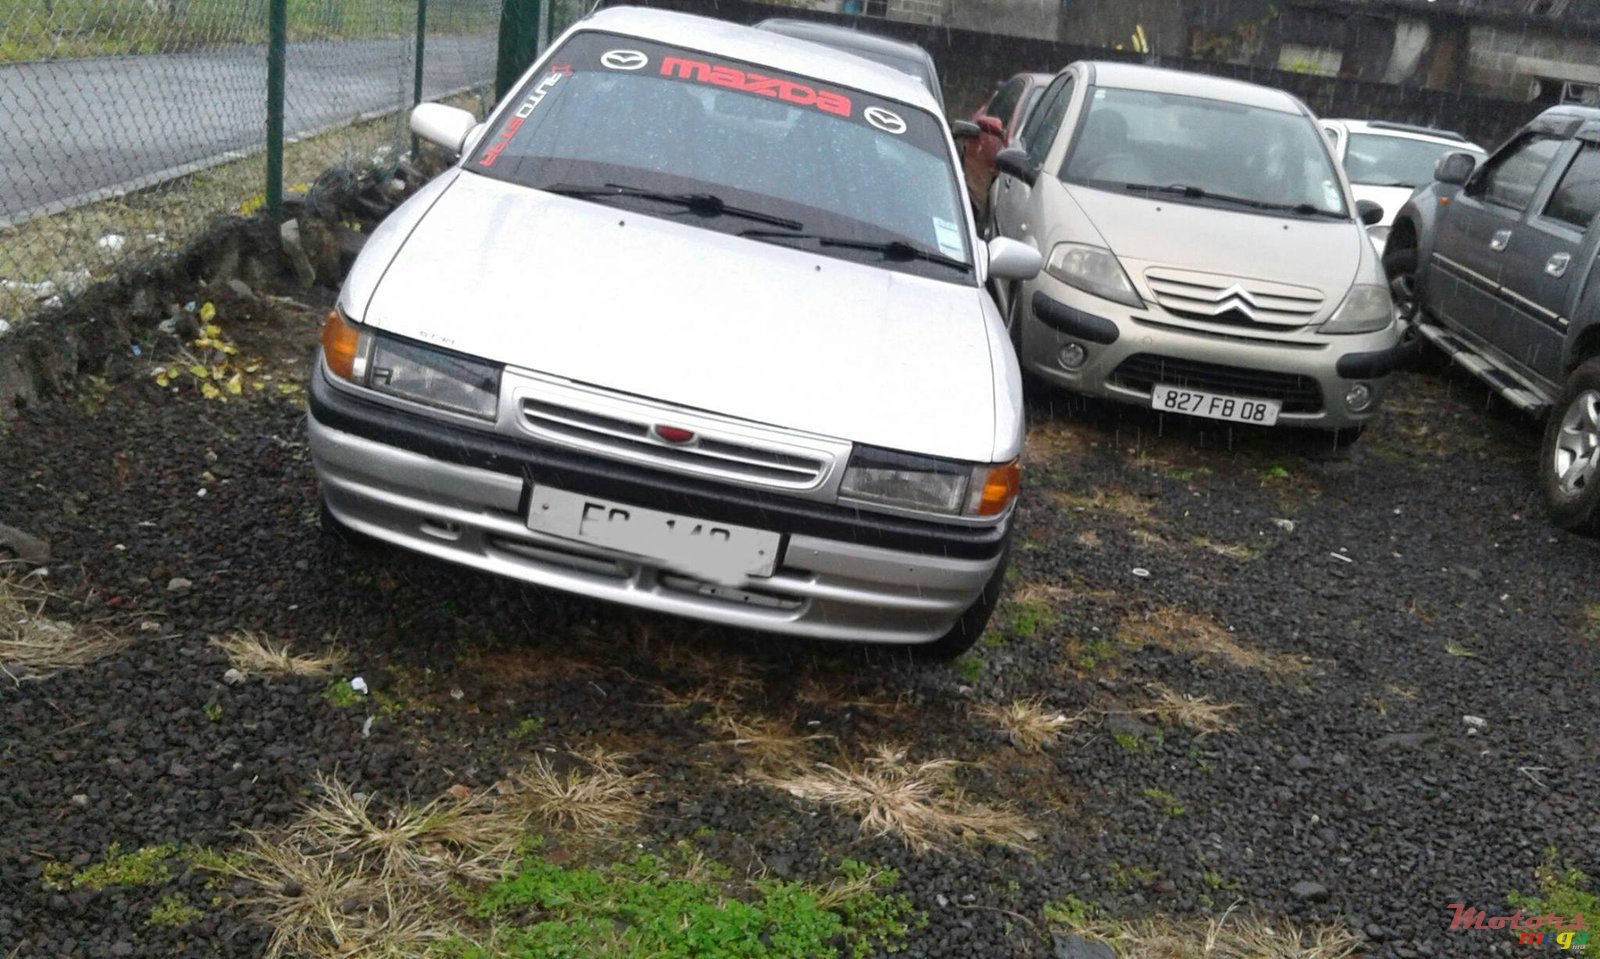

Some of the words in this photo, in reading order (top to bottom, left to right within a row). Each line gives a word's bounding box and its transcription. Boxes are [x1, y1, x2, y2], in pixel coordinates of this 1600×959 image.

[1164, 390, 1204, 412] 827
[1208, 396, 1236, 417] FB
[1240, 401, 1267, 421] 08
